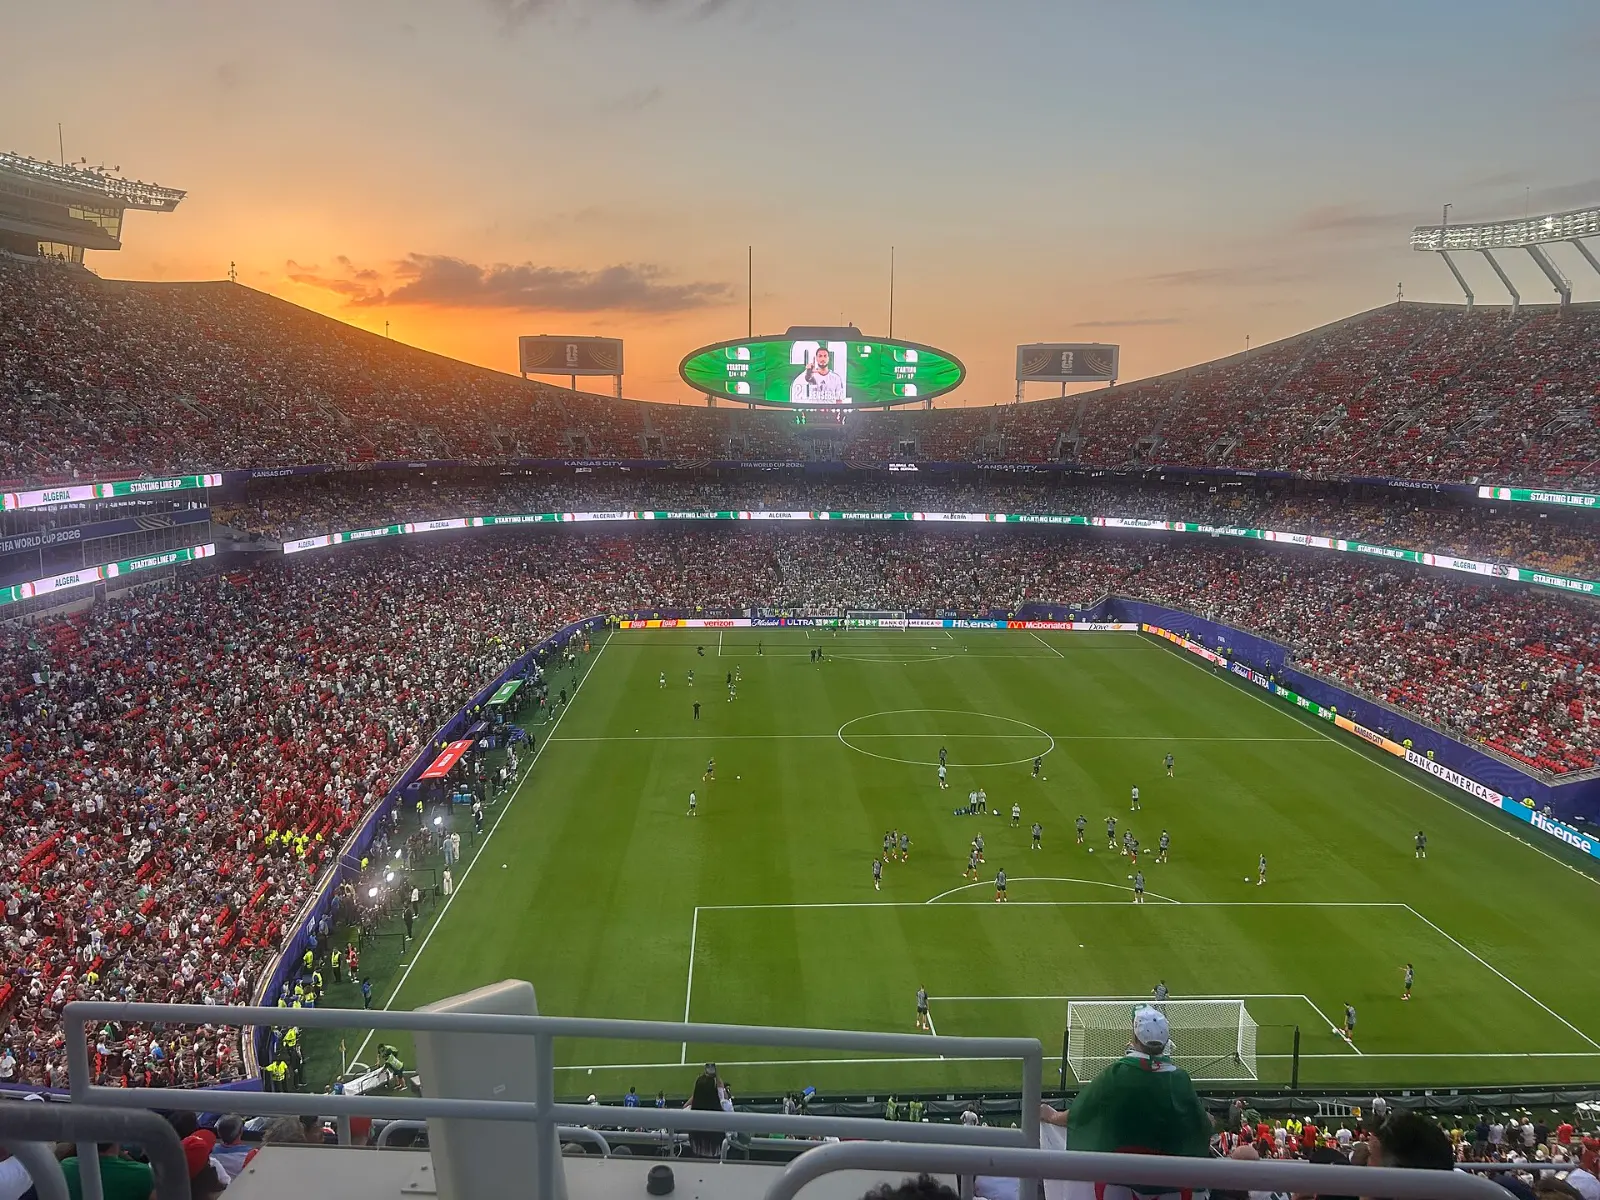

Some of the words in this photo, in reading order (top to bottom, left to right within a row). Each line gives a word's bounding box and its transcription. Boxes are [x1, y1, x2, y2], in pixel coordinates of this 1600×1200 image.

[280, 469, 294, 477] CITY
[130, 482, 158, 493] STARTING
[160, 481, 172, 490] LINE
[172, 480, 182, 488] UP
[1388, 480, 1420, 488] KANSAS
[42, 490, 70, 502] ALGERIA
[1530, 492, 1566, 504] STARTING
[1567, 496, 1582, 505] LINE
[1582, 498, 1596, 506] UP
[14, 536, 40, 550] WORLD
[42, 533, 56, 545] CUP
[56, 530, 81, 542] 2026
[130, 560, 158, 570] STARTING
[158, 556, 168, 566] LINE
[169, 554, 176, 564] UP
[1452, 561, 1477, 570] ALGERIA
[55, 574, 80, 588] ALGERIA
[1533, 574, 1566, 588] STARTING
[1566, 580, 1582, 590] LINE
[1582, 582, 1594, 592] UP
[952, 620, 998, 628] Hisense
[1025, 621, 1072, 630] McDonald's
[1252, 674, 1270, 690] ULTRA
[1354, 726, 1372, 740] KANSAS
[1372, 734, 1384, 746] CITY
[1408, 752, 1430, 772] BANK
[1433, 765, 1444, 776] OF
[1446, 770, 1488, 799] AMERICA
[1530, 811, 1592, 854] Hisense
